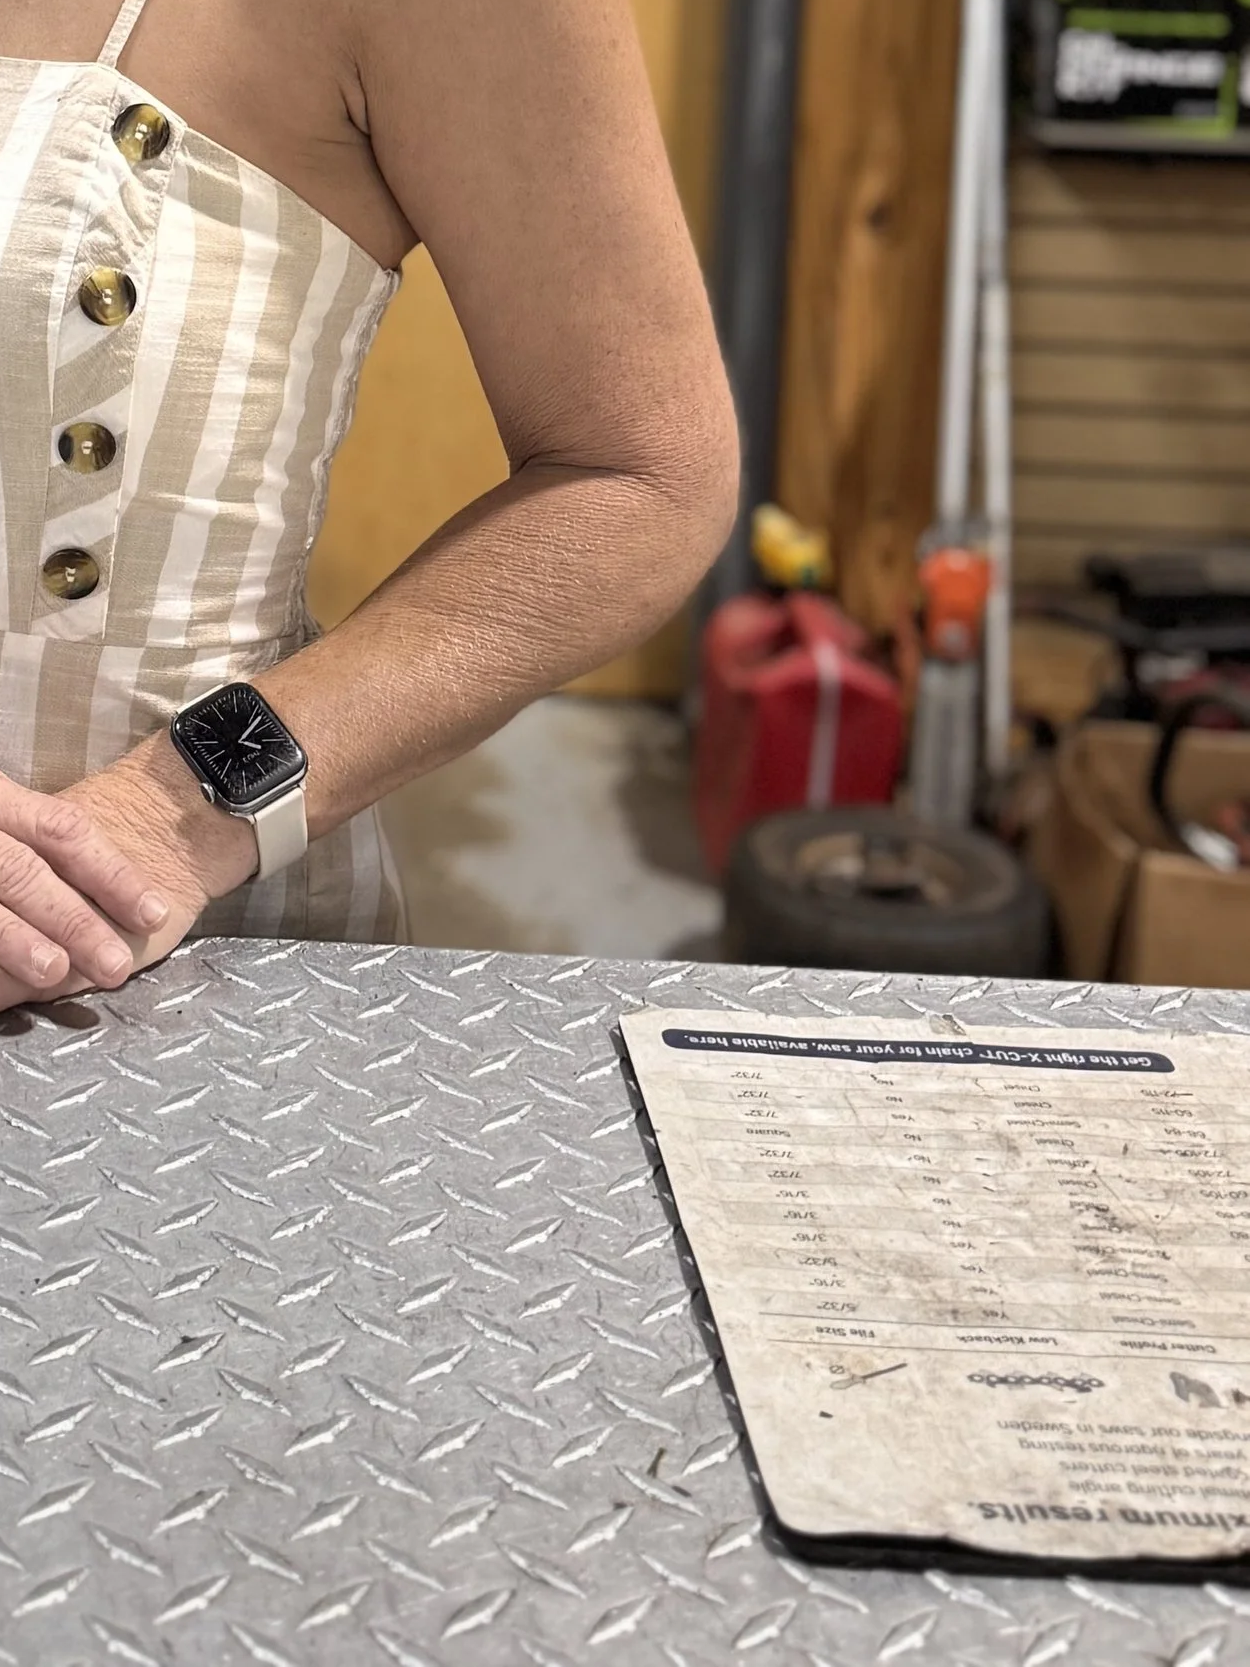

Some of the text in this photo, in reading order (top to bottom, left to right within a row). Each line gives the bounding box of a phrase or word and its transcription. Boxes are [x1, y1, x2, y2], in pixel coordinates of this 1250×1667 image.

[684, 1035, 728, 1047] here.
[732, 1037, 807, 1052] available
[856, 1044, 894, 1054] your
[899, 1045, 922, 1056] for
[926, 1046, 973, 1058] chain
[1045, 1052, 1085, 1065] right
[1090, 1055, 1118, 1066] the
[1123, 1056, 1151, 1067] Get
[890, 1114, 915, 1122] Yes
[746, 1127, 791, 1138] Square
[903, 1133, 922, 1141] No
[922, 1175, 940, 1184] No
[932, 1197, 951, 1206] No
[942, 1220, 961, 1228] No
[950, 1241, 976, 1250] Yes
[960, 1264, 985, 1274] Yes
[971, 1286, 998, 1295] Yes
[982, 1309, 1010, 1320] Yes
[815, 1326, 875, 1338] File Size
[956, 1335, 1058, 1347] Low Kickback
[1120, 1340, 1217, 1355] Cutter Profile
[997, 1420, 1073, 1436] Sweden
[1076, 1422, 1093, 1436] in
[1097, 1424, 1144, 1437] saws
[1150, 1427, 1180, 1439] our
[1018, 1437, 1085, 1454] testing
[1088, 1442, 1167, 1457] rigorous
[1172, 1446, 1189, 1461] of
[1058, 1460, 1126, 1475] cutters
[1132, 1463, 1178, 1477] steel
[1068, 1479, 1122, 1495] angle
[1127, 1482, 1195, 1499] cutting
[966, 1501, 1110, 1525] results.
